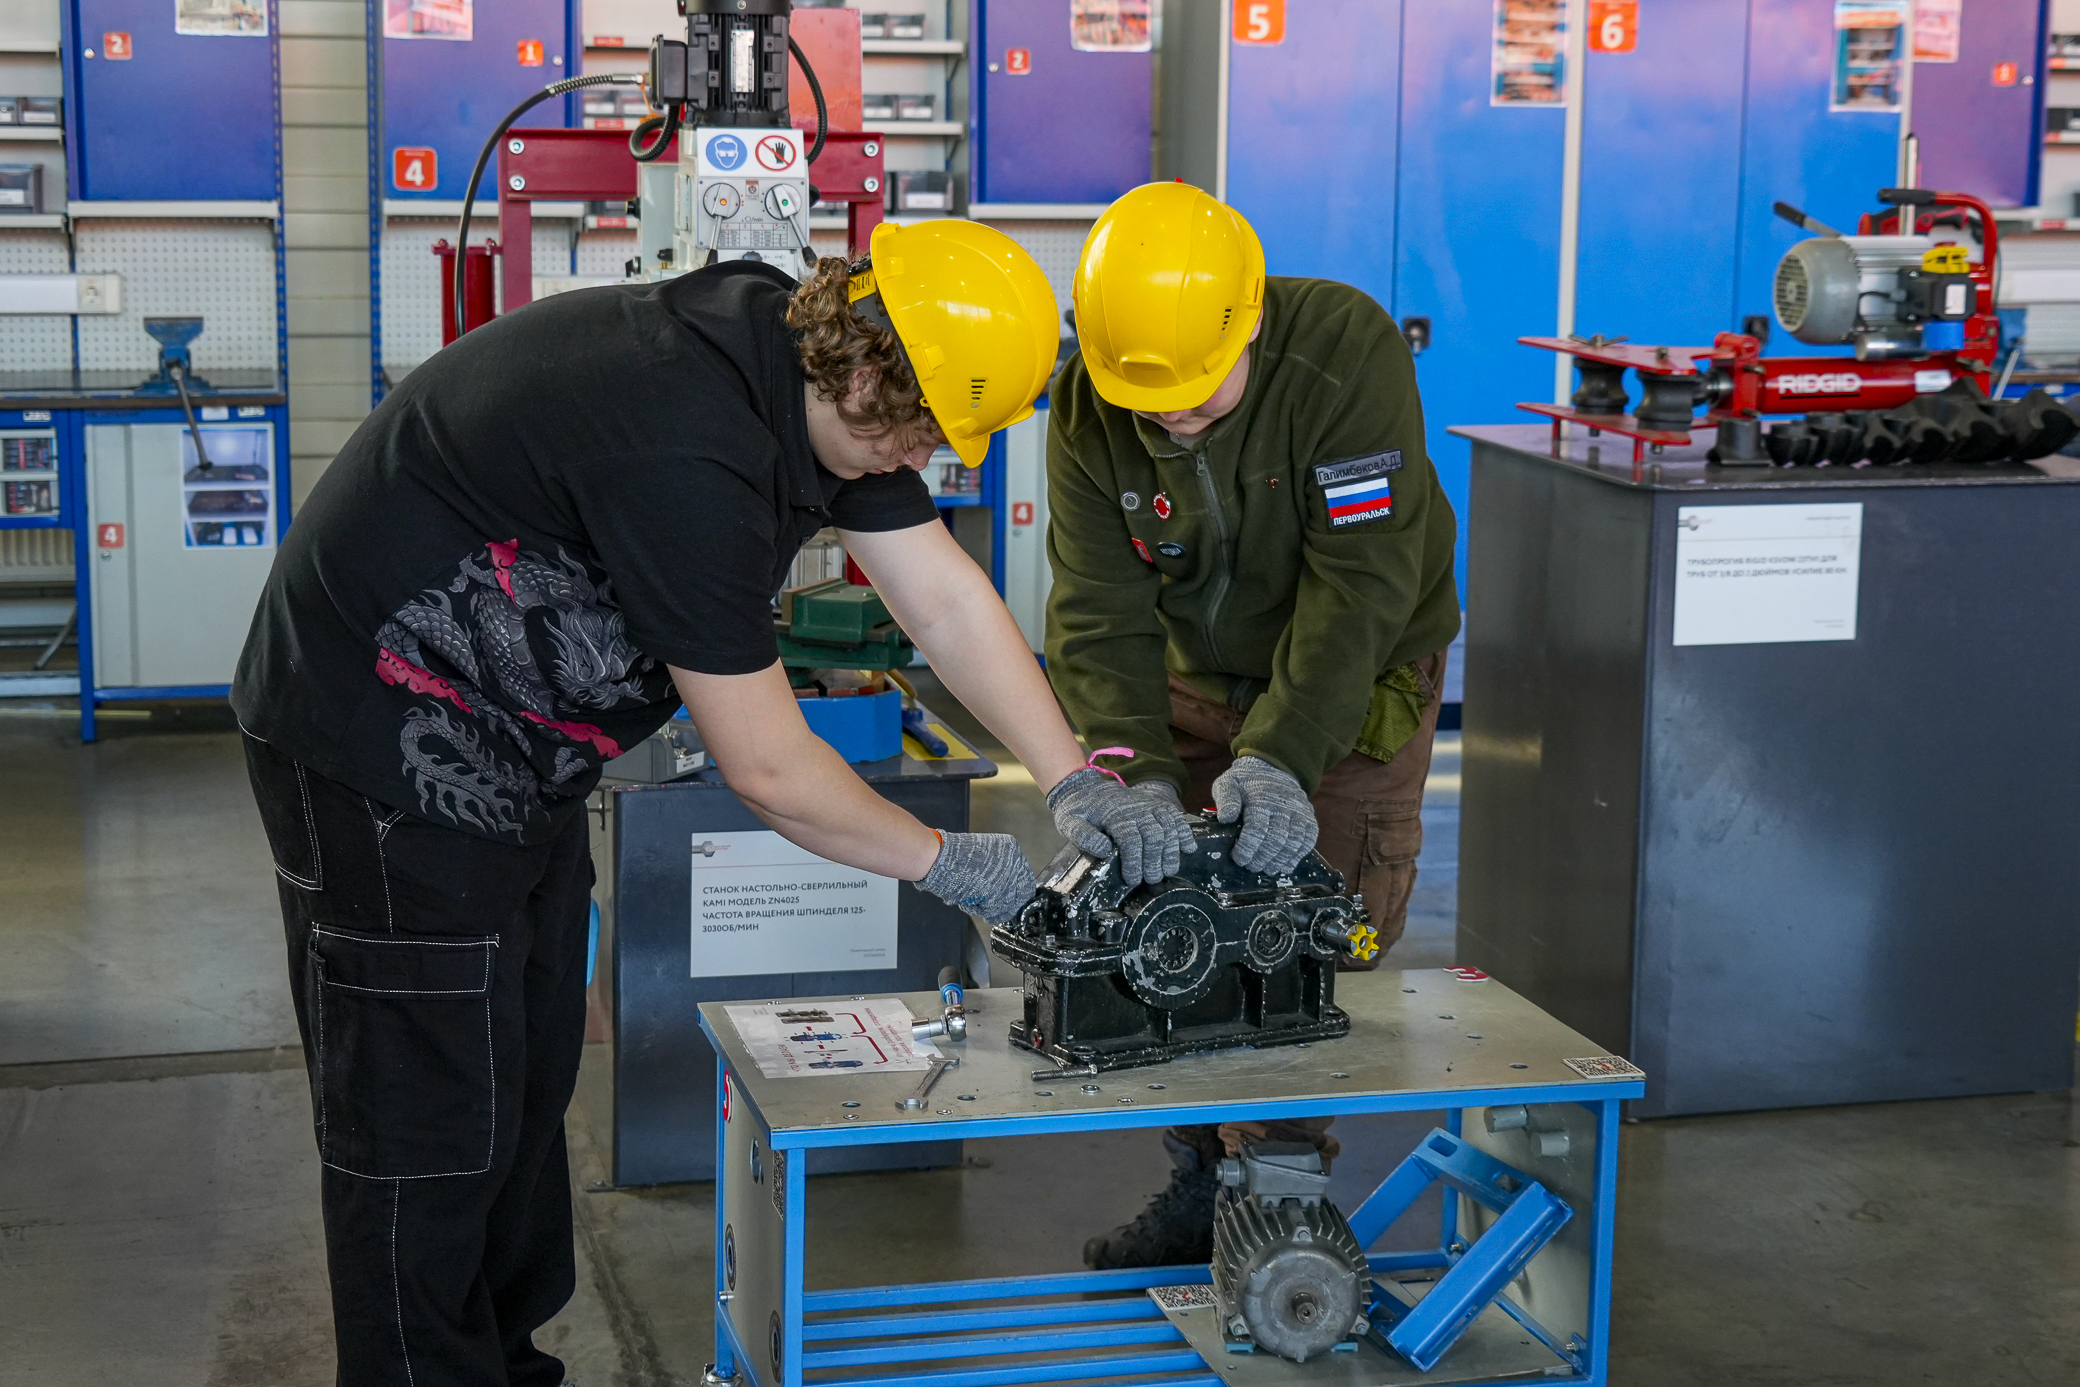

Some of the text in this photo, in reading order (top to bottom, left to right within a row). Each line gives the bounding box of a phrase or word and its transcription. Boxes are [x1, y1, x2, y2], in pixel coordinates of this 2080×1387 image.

[1247, 5, 1269, 40] 5
[1601, 13, 1624, 49] 6
[111, 35, 124, 54] 2
[1013, 52, 1023, 68] 2
[405, 159, 425, 187] 4
[1779, 372, 1863, 394] RIDGID
[1016, 504, 1028, 521] 4
[1333, 506, 1391, 526] ПЕРВОУРАЛЬСК
[104, 526, 118, 543] 4
[702, 880, 868, 895] СТАНОК НАСТОЛЬНО-СВЕРЛИЛЬНЫЙ
[728, 897, 767, 907] МОДЕЛЬ
[768, 896, 800, 905] ZN4025
[702, 906, 866, 920] ЧАСТОТА ВРАЩЕНИЯ ШПИНДЕЛЯ 125-
[702, 922, 759, 933] 3030ОБ/МИН
